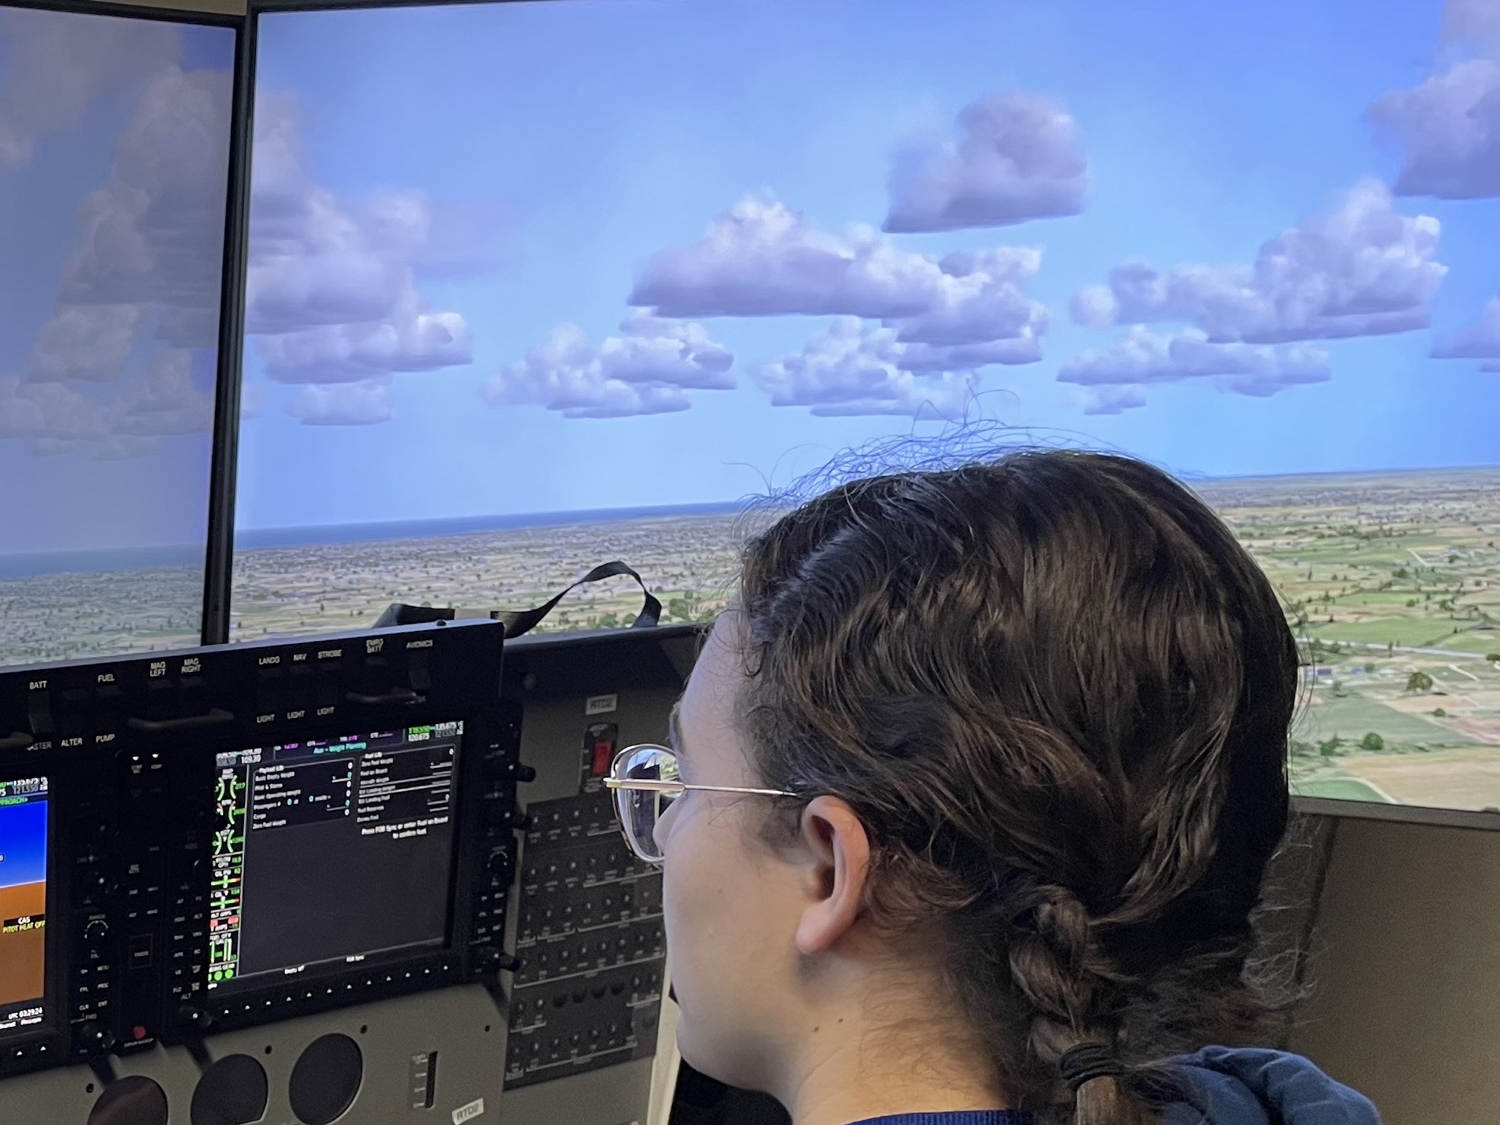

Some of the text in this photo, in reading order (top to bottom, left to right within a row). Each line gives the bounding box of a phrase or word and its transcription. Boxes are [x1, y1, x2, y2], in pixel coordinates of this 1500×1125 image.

[293, 653, 307, 662] NAV
[150, 661, 166, 670] MAG
[184, 658, 199, 667] MAG
[150, 668, 166, 677] LEFT
[181, 664, 201, 674] RIGHT
[97, 674, 115, 683] FUEL
[29, 681, 47, 690] BATT
[287, 710, 305, 720] LIGHT
[317, 707, 334, 716] LIGHT
[257, 714, 275, 723] LIGHT
[61, 737, 83, 747] ALTER
[96, 734, 115, 743] PUMP
[18, 916, 30, 924] CAS
